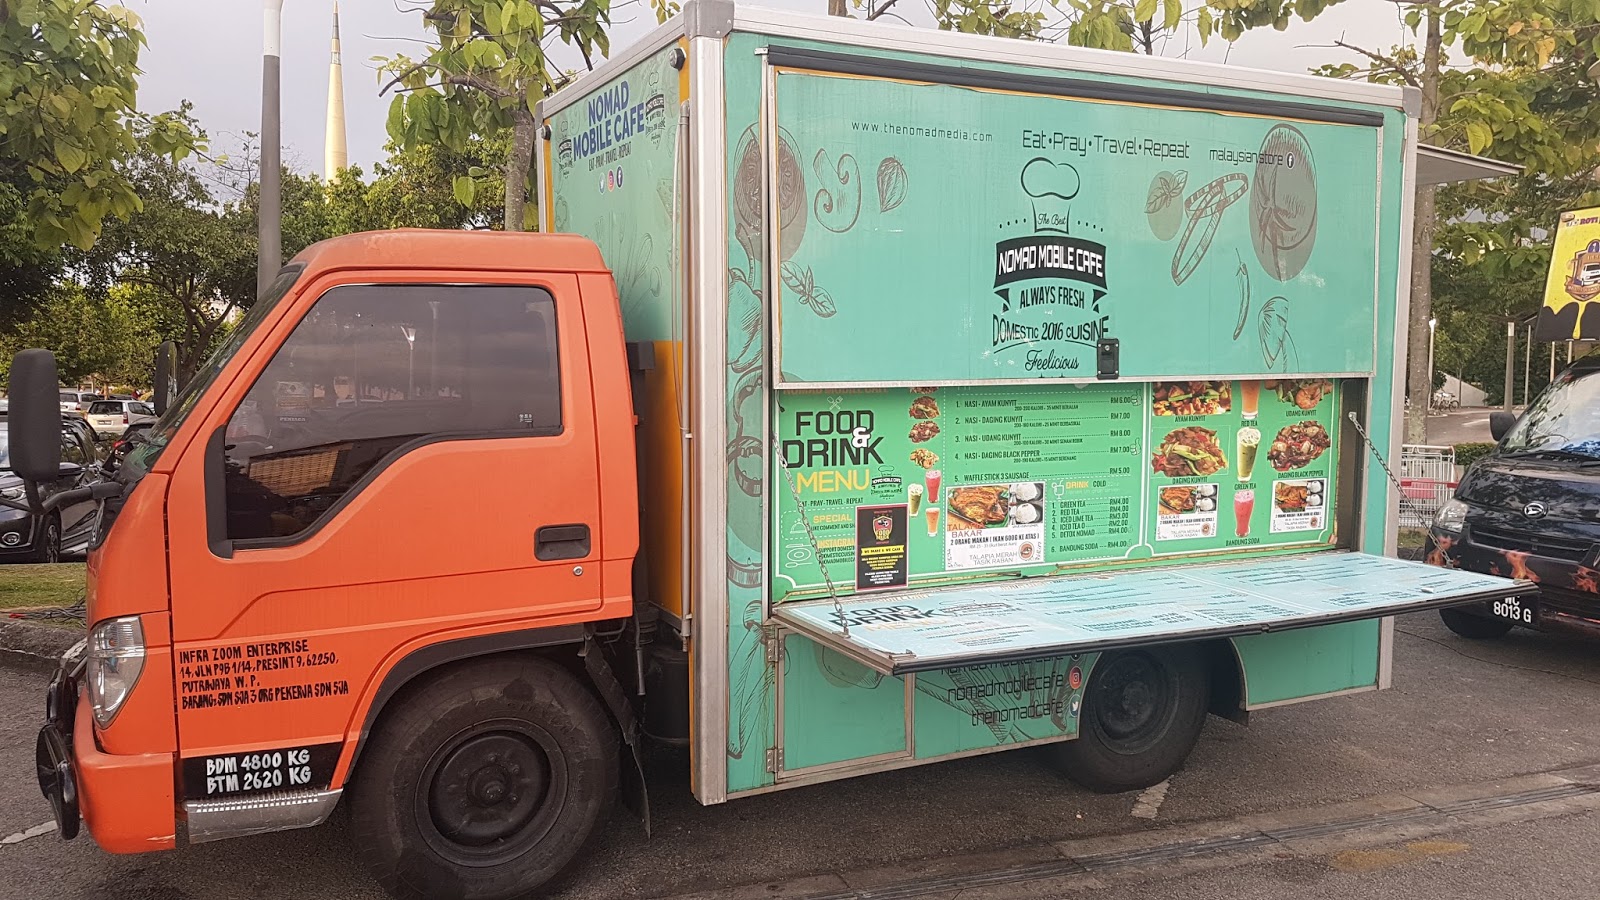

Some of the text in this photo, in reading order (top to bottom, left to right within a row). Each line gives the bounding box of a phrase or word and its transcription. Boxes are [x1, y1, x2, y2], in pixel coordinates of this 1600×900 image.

[588, 81, 629, 127] NOMAD
[573, 119, 612, 161] MOBILE
[614, 102, 644, 142] CAFE
[851, 121, 993, 142] www.thenomadmedia.com
[1038, 213, 1050, 225] The
[998, 245, 1103, 277] NOMAD MOBILE CAFE
[1020, 286, 1085, 309] ALWAYS FRESH
[993, 314, 1039, 346] DOMESTIC
[1041, 322, 1063, 340] 2016
[1024, 349, 1079, 371] Feelicious
[965, 400, 978, 408] NASI
[981, 400, 997, 408] AYAM
[1110, 396, 1119, 404] RM
[796, 410, 874, 436] FOOD
[982, 416, 1002, 424] DAGING
[851, 426, 871, 448] &
[982, 434, 1001, 442] UDANG
[1002, 433, 1021, 441] KUNYIT
[782, 437, 885, 468] DRINK
[965, 452, 978, 460] NASI
[981, 451, 1002, 459] DAGING
[1003, 450, 1020, 458] BLACK
[796, 469, 870, 493] MENU
[963, 474, 983, 482] WAFFLE
[984, 473, 999, 481] STICK
[1005, 472, 1029, 480] SAUSAGE
[1118, 466, 1130, 474] 5.00
[1065, 480, 1106, 489] DRINK COLD
[1172, 477, 1189, 485] DAGING
[813, 513, 852, 524] SPECIAL
[951, 530, 983, 539] BAKAR
[954, 538, 971, 546] ORANG
[1076, 529, 1095, 537] NOMAD
[969, 553, 994, 561] TALAPIA
[1059, 544, 1084, 552] BANDUNG
[1107, 540, 1127, 548] RM4.00
[1493, 601, 1532, 623] 8013 G
[179, 639, 309, 664] INFRA ZOOM ENTERPRISE
[182, 677, 230, 694] PUTRAJAYA
[250, 690, 256, 704] 3
[275, 683, 313, 701] PEKERJA
[314, 682, 331, 696] SDN
[947, 671, 1064, 703] nomadmobilecafe
[971, 699, 1064, 726] thenomadcafe
[206, 749, 311, 776] BDM 4800 KG
[206, 766, 312, 794] BTM 2620 KG
